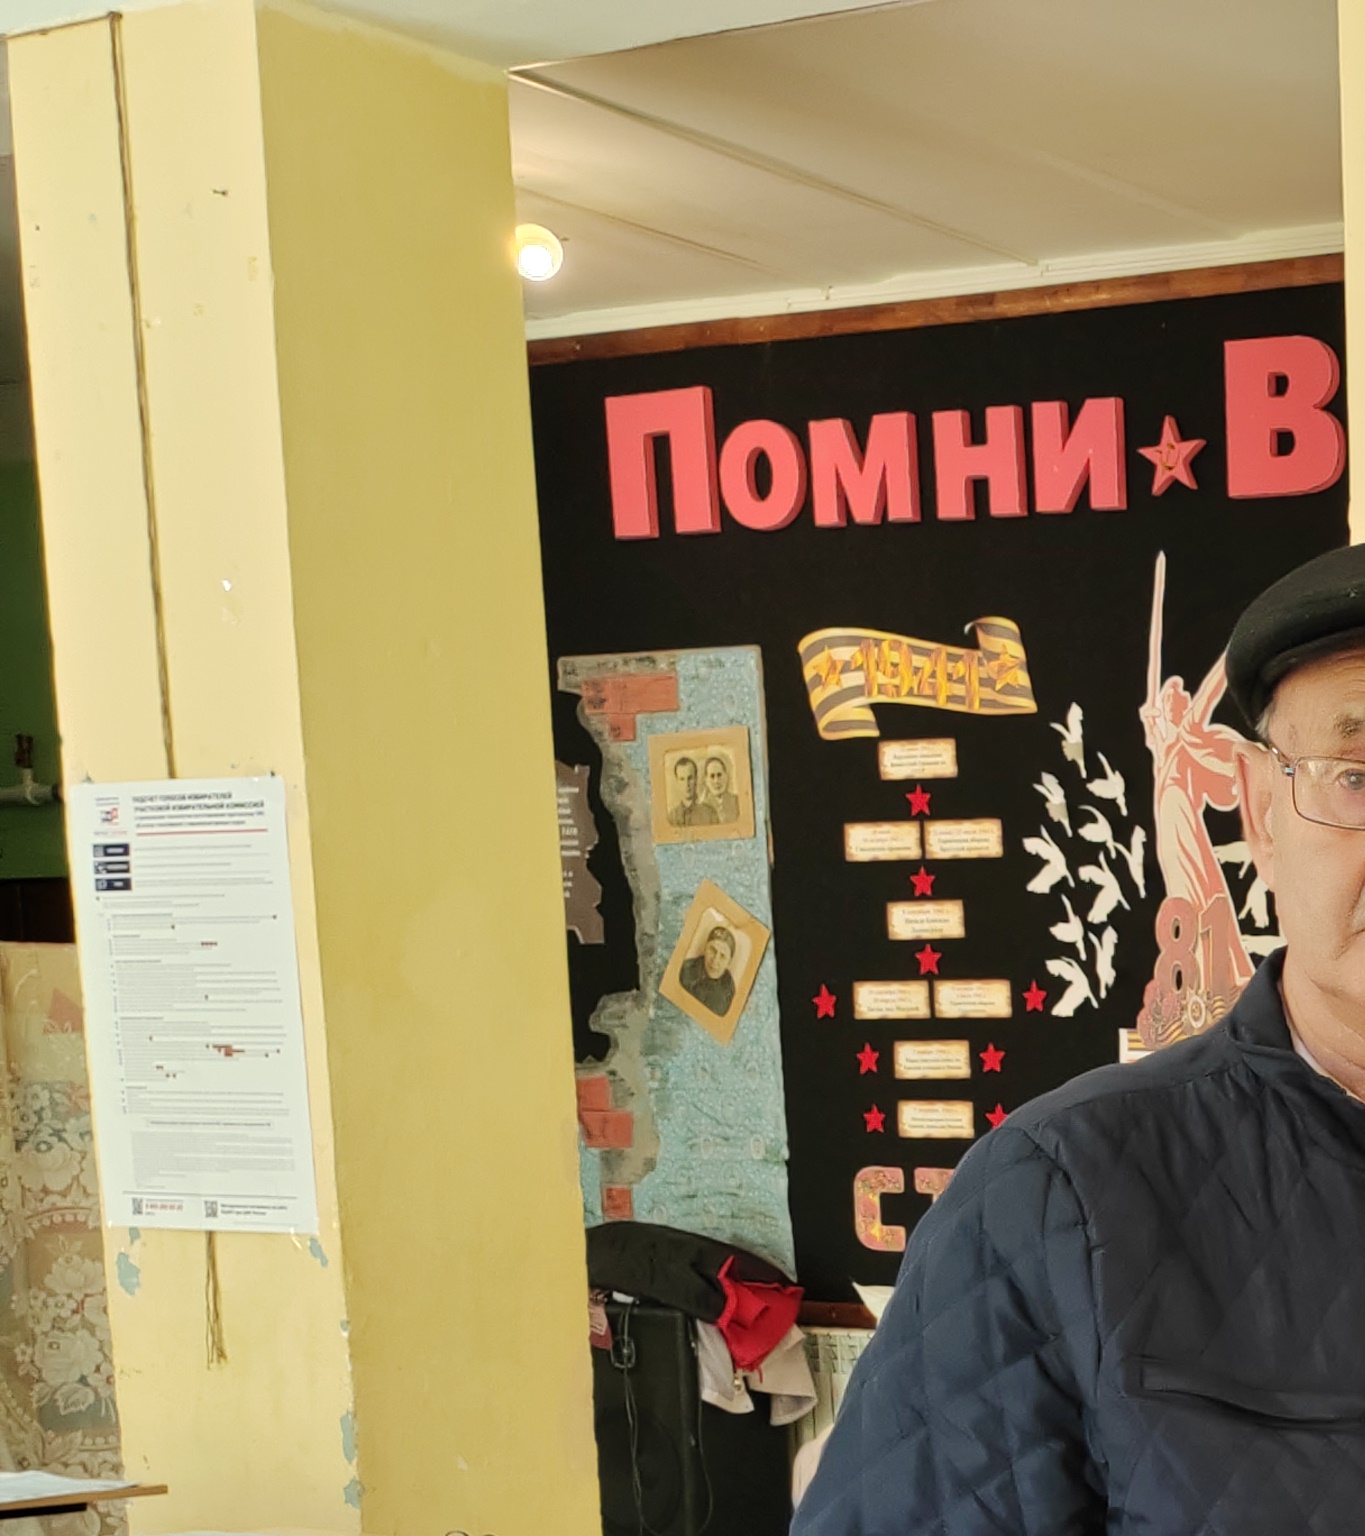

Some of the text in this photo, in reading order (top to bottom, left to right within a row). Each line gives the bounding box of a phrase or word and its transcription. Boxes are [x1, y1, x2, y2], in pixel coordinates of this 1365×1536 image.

[604, 335, 1346, 540] Помни В
[851, 638, 981, 710] 1941
[1155, 896, 1236, 1000] 81
